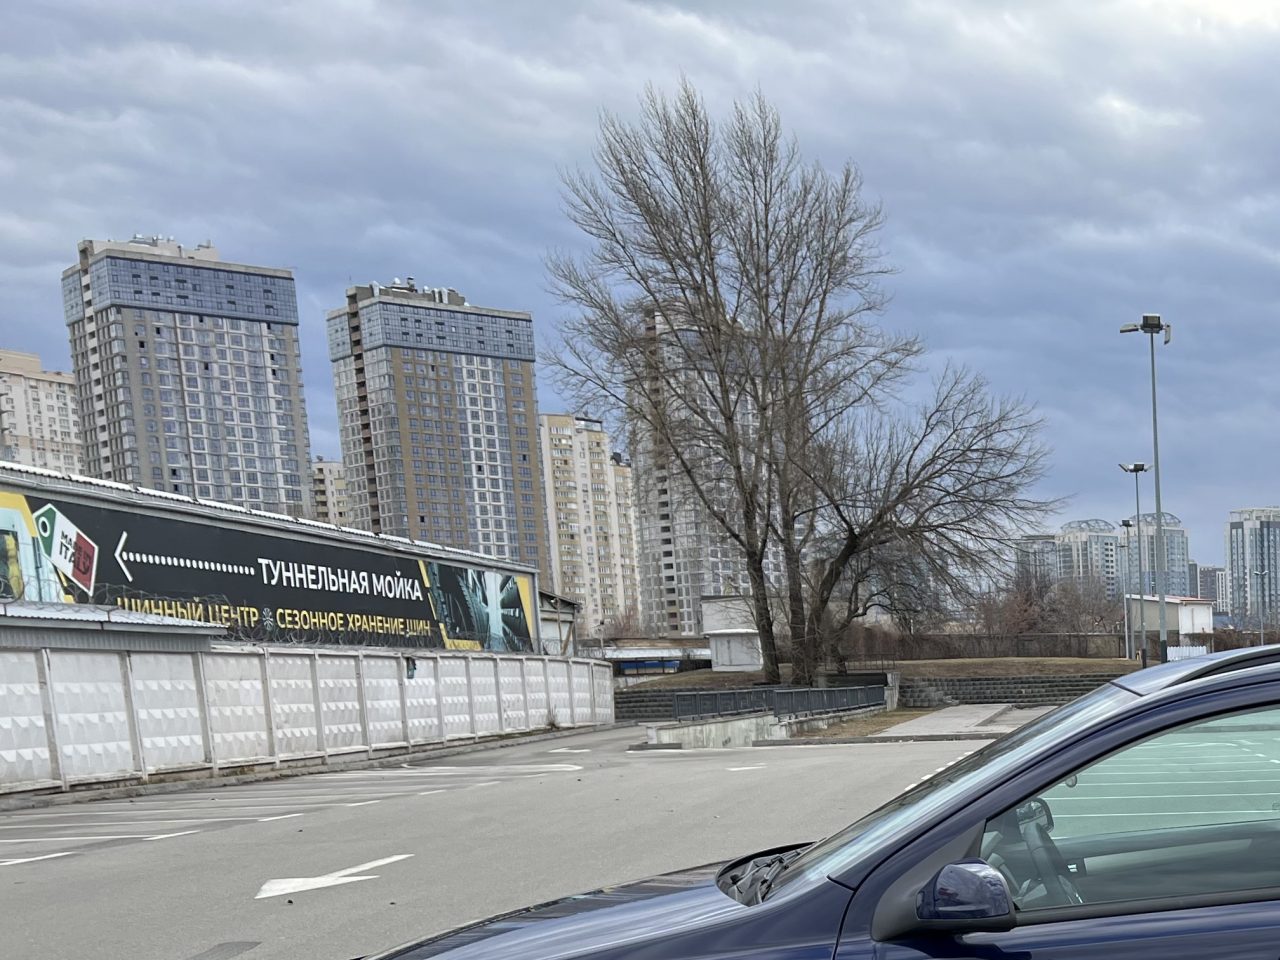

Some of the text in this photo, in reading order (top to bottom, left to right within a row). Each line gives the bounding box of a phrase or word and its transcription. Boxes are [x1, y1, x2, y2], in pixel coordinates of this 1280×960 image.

[257, 558, 424, 601] ТУННЕЛЬНАЯ МОЙКА
[208, 604, 260, 628] ЦЕНТР
[276, 607, 345, 632] СЕЗОННОЕ
[346, 613, 405, 635] ХРАНЕНИЕ
[405, 618, 431, 637] ШИН
